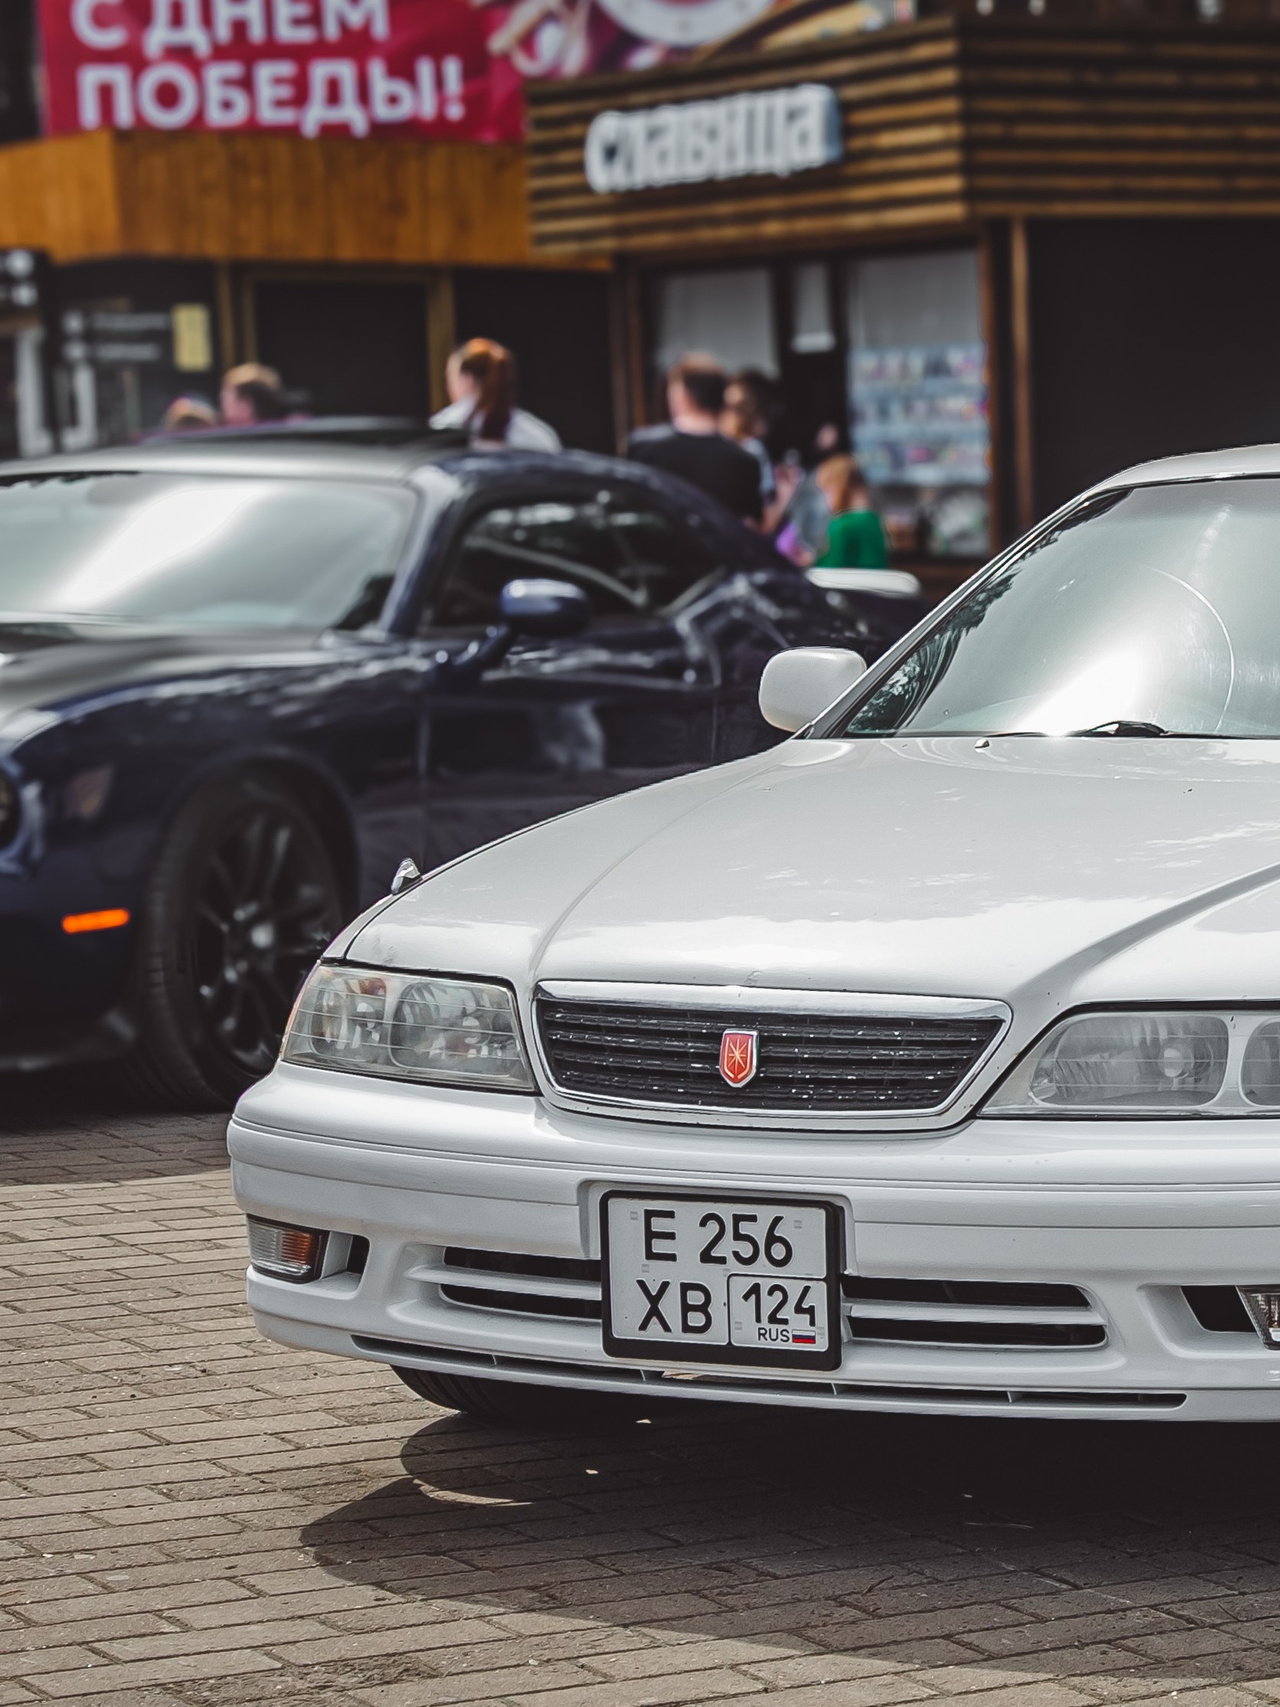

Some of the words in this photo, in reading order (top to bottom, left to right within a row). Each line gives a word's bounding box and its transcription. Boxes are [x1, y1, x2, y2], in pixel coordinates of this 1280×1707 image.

[71, 0, 128, 51] С
[143, 0, 391, 60] ДНЕМ
[76, 55, 466, 139] ПОБЕДЫ!
[699, 1212, 794, 1268] 256
[742, 1282, 816, 1327] 124
[757, 1328, 791, 1343] RUS
